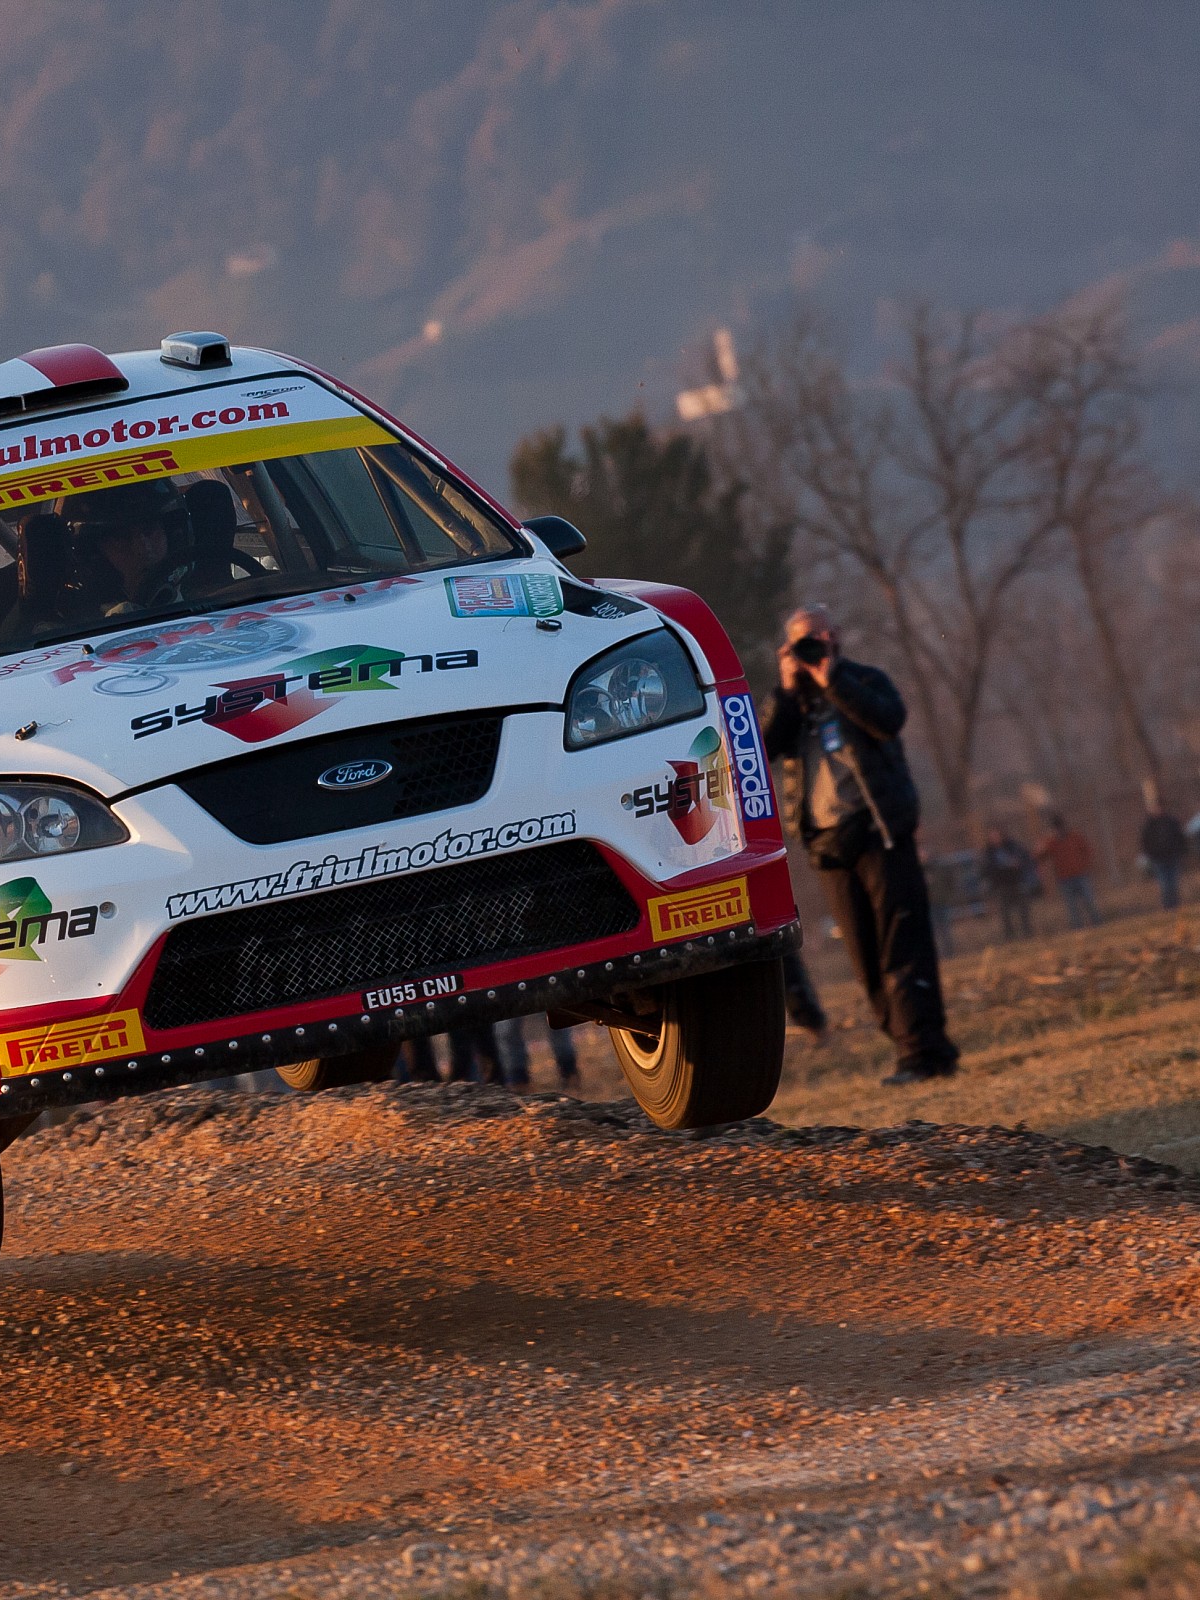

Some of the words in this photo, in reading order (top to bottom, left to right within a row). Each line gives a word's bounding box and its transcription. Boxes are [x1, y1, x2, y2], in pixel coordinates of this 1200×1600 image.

[335, 760, 378, 783] Ford
[724, 696, 766, 818] sparco
[165, 811, 577, 919] www.friulmotor.com
[658, 886, 743, 933] PIRELLI
[365, 983, 418, 1010] EU55
[422, 975, 457, 998] CNJ
[6, 1019, 128, 1068] PIRELLI
